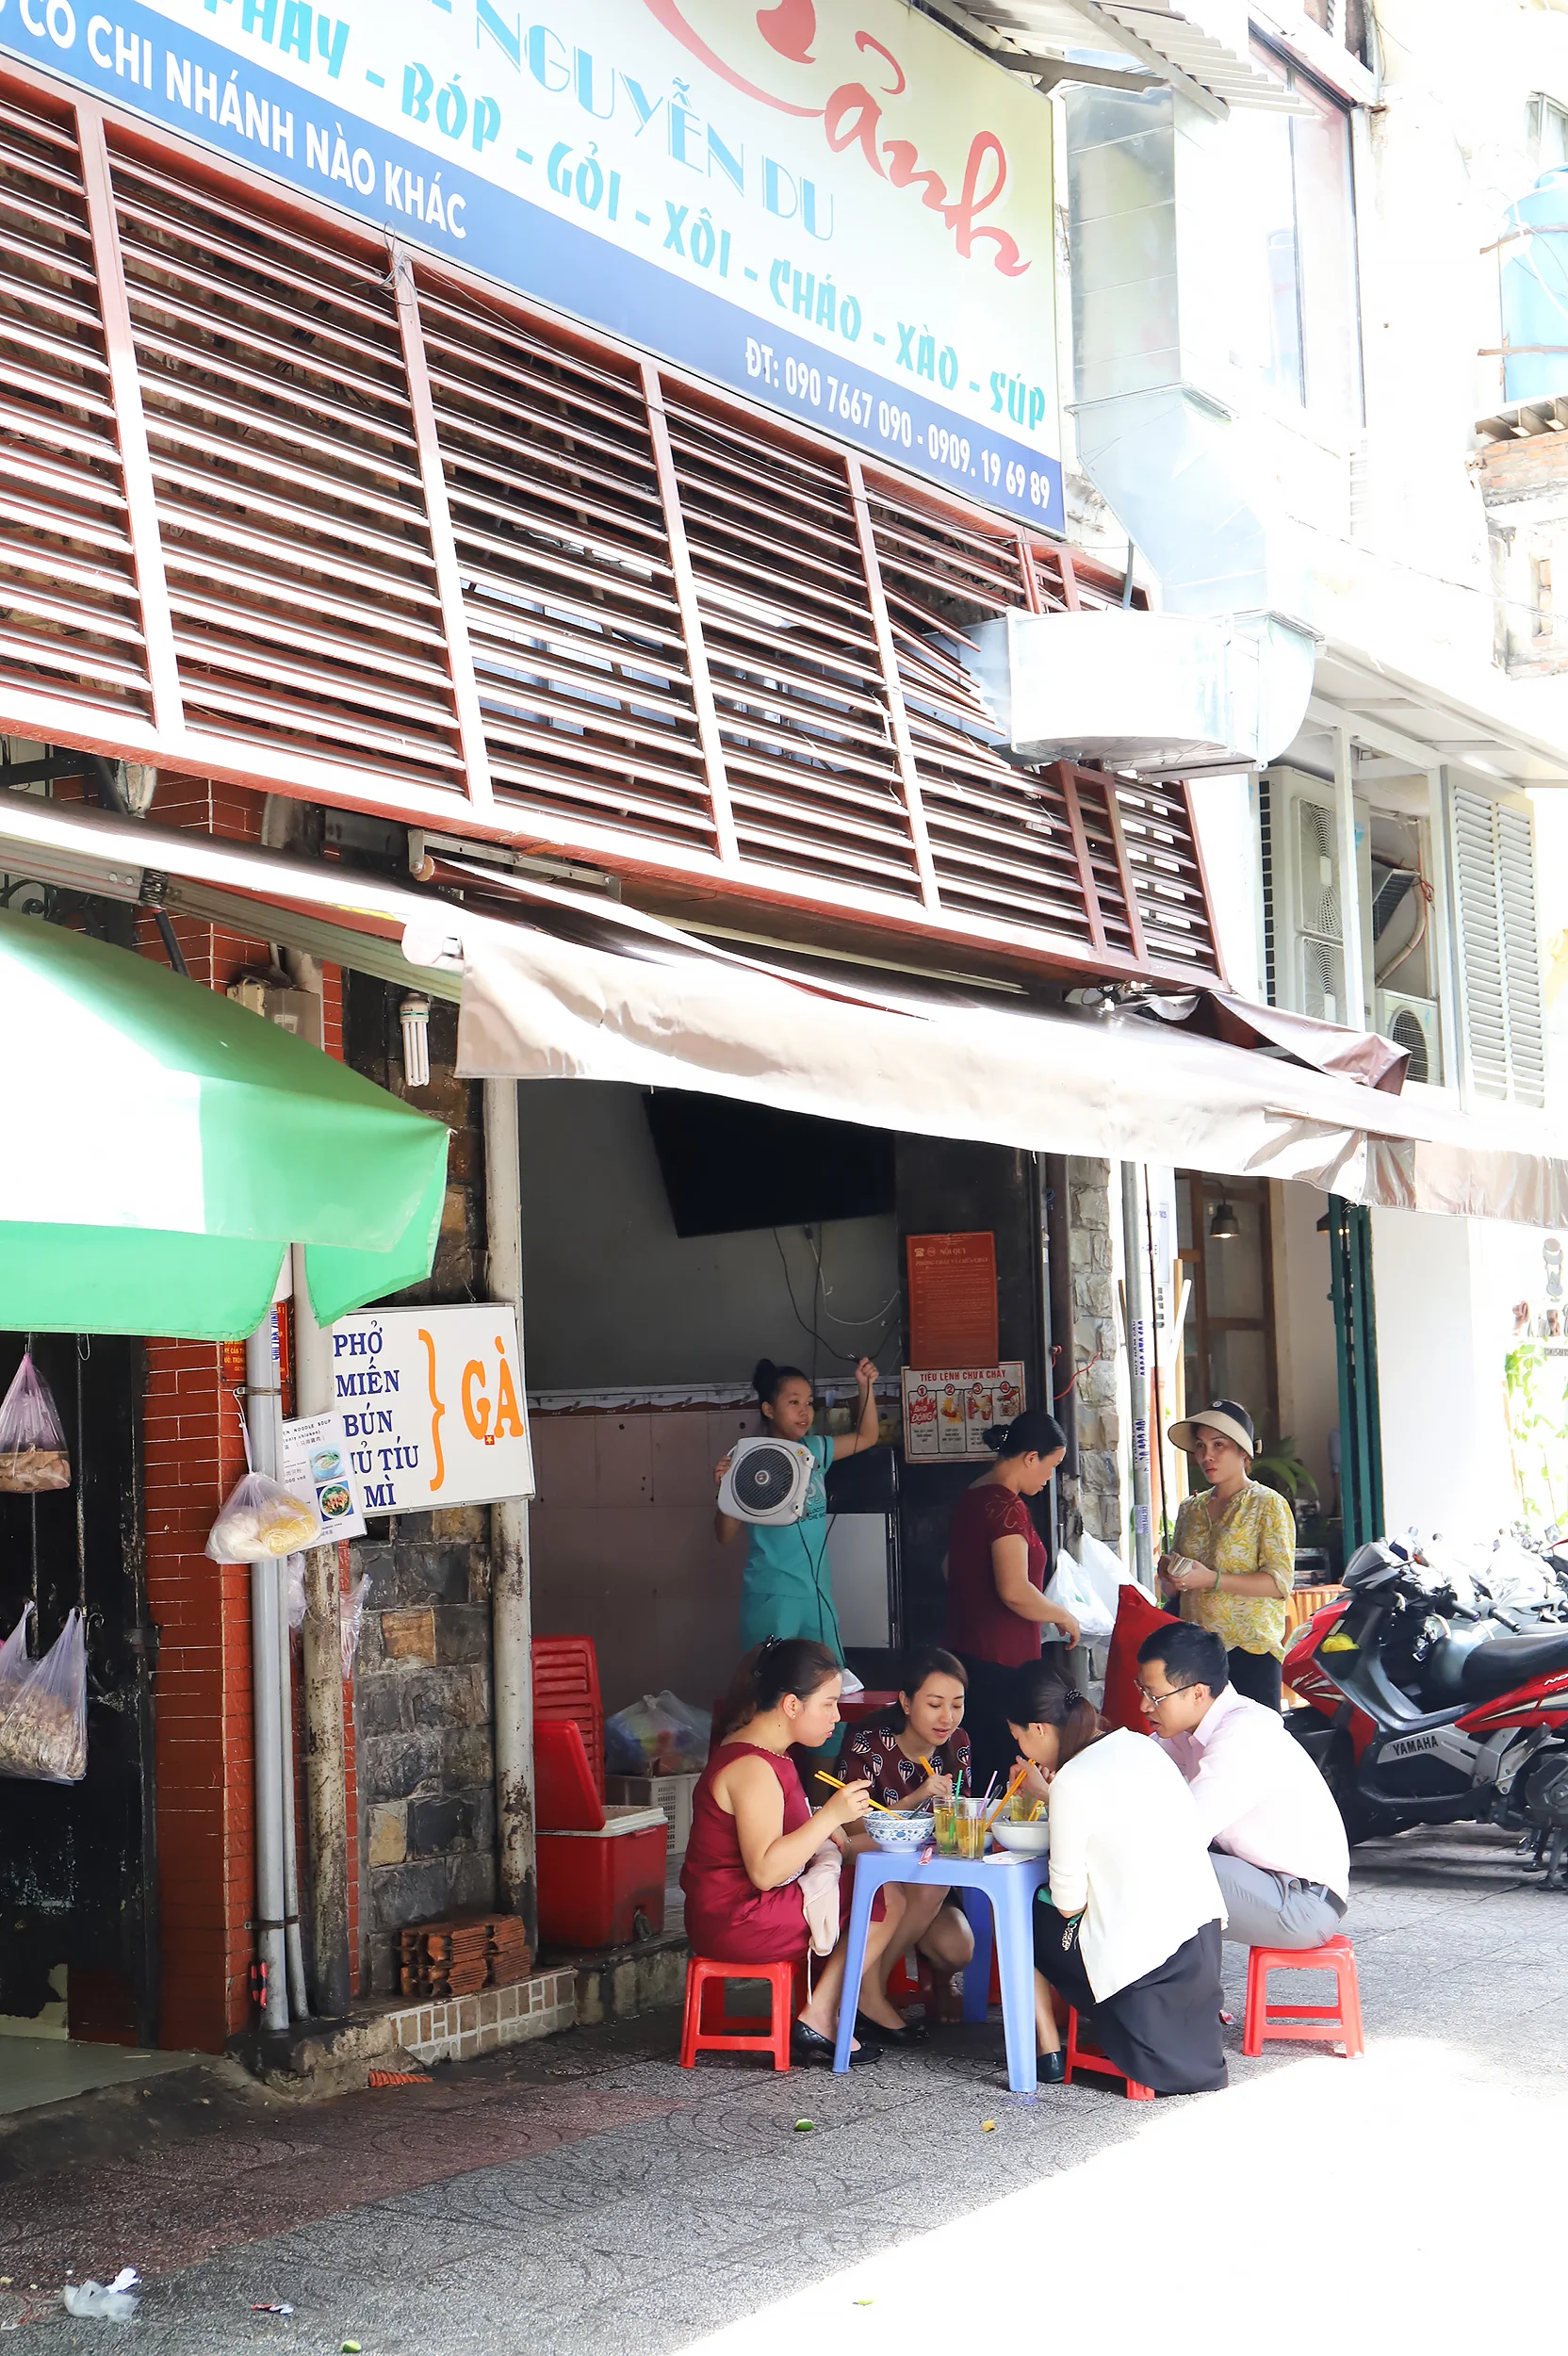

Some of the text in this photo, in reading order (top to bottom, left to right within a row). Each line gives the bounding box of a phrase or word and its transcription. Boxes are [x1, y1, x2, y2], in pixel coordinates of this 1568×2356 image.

[87, 15, 152, 90] CHI
[166, 50, 294, 159] NHÁNH
[306, 121, 375, 196] NÀO
[384, 160, 466, 239] KHÁC
[476, 0, 744, 198] NGUYỄN
[761, 155, 833, 241] DU
[402, 61, 501, 153] BÓP
[547, 141, 620, 221] GỎI
[663, 199, 731, 278] XÔI
[770, 258, 861, 342] CHÁO
[897, 322, 958, 389] XÀO
[991, 370, 1045, 431] SÚP
[745, 336, 779, 390] ĐT:
[785, 356, 822, 405] 090
[827, 376, 873, 428] 7667
[878, 401, 912, 449] 090
[981, 449, 1002, 485] 19
[1005, 459, 1027, 499] 69
[1030, 471, 1051, 510] 89
[333, 1320, 383, 1357] PHỞ
[335, 1356, 400, 1397] MIẾN
[462, 1336, 524, 1439] GÀ
[343, 1402, 392, 1437] BÚN
[378, 1435, 418, 1471] TÍU
[364, 1474, 397, 1508] MÌ
[1393, 1735, 1438, 1757] YAMAHA
